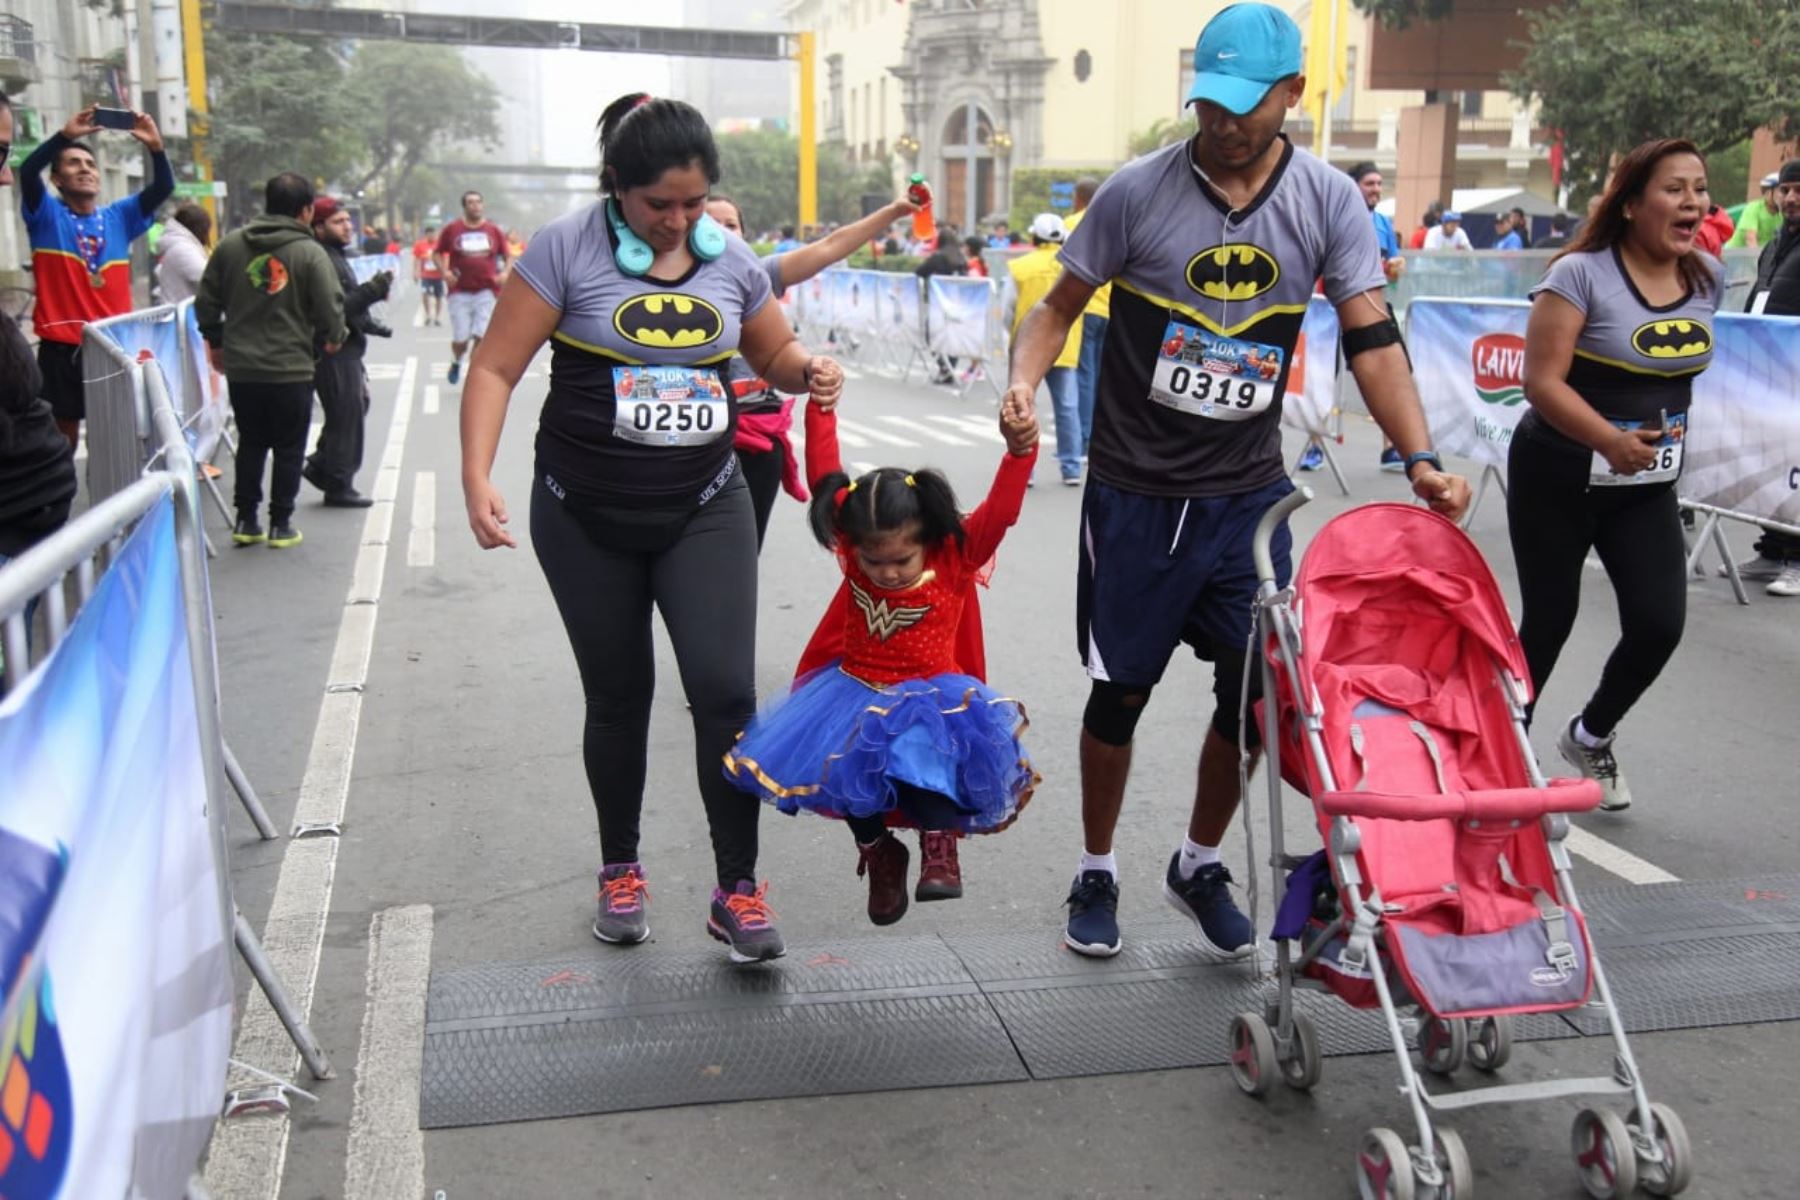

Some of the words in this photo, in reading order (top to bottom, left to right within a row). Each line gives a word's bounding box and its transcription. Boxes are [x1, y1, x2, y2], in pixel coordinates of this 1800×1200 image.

[1209, 341, 1237, 357] 10K
[1169, 366, 1256, 409] 0319
[633, 403, 714, 432] 0250
